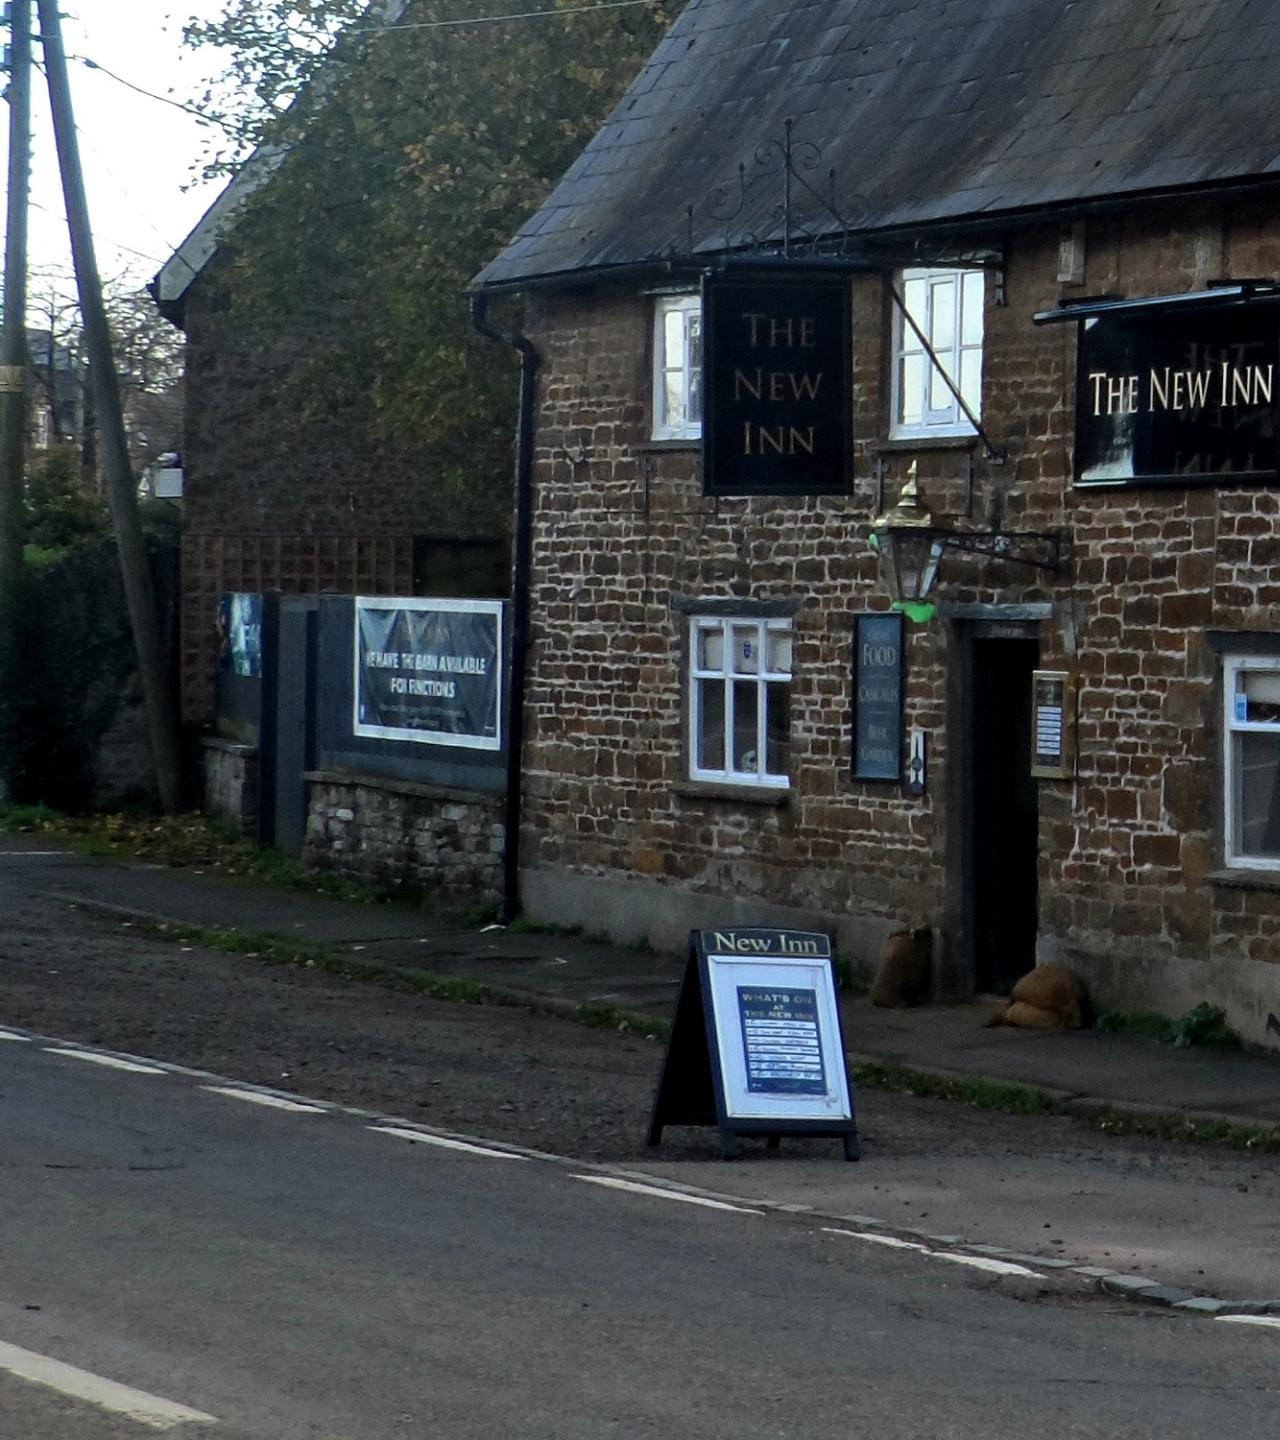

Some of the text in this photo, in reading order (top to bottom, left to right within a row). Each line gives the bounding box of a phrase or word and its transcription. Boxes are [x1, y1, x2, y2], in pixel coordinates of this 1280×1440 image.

[742, 313, 817, 348] THE
[734, 368, 824, 401] NEW
[1088, 362, 1275, 416] THE NEW INN
[743, 421, 816, 455] INN
[863, 643, 897, 666] FOOD
[713, 931, 819, 954] New Inn
[743, 993, 790, 1003] WHAT'S
